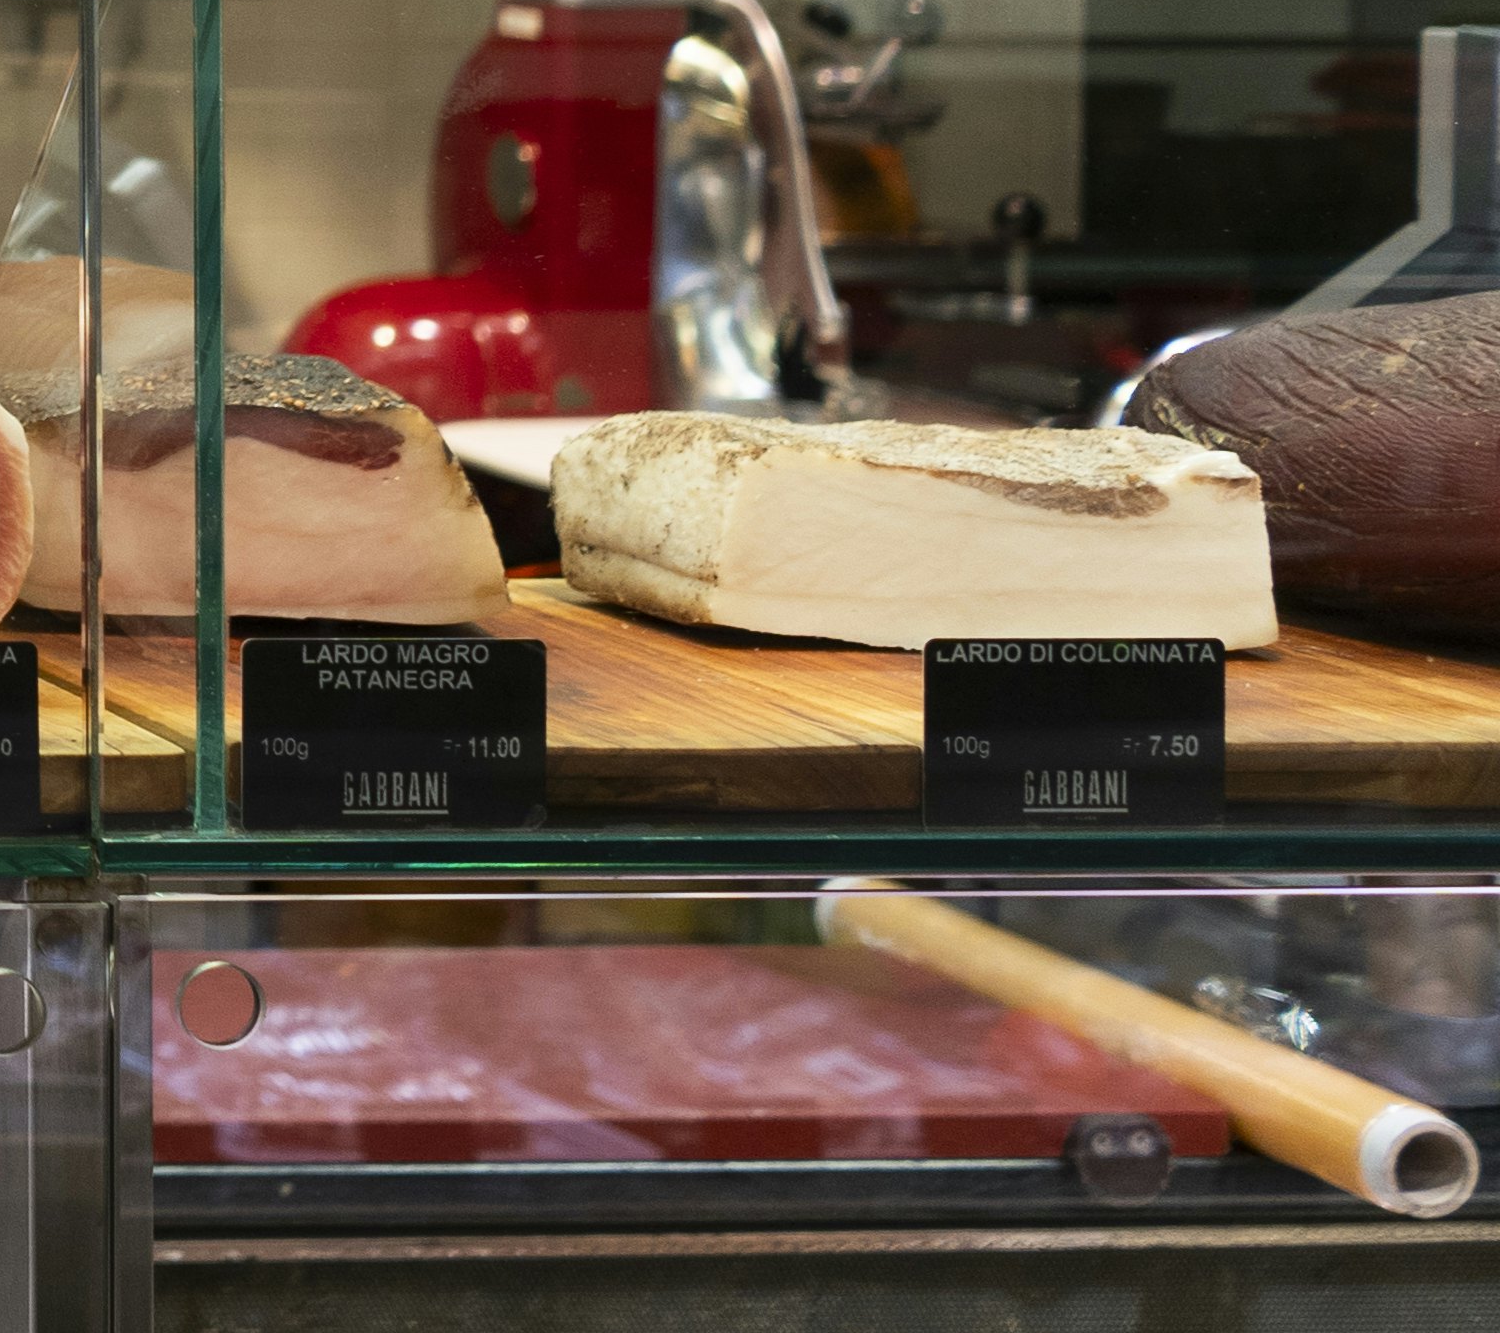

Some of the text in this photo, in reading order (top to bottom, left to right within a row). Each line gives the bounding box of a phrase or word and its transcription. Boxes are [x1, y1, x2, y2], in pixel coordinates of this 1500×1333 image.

[302, 643, 490, 664] LARDO MAGRO
[1029, 642, 1053, 663] DI
[1060, 642, 1216, 663] COLONNATA
[318, 669, 474, 690] PATANEGRA
[260, 737, 309, 761] 100g
[467, 736, 521, 758] 11.00
[942, 735, 991, 759] 100g
[1148, 734, 1199, 757] 7.50
[343, 771, 448, 808] GABBANI
[1023, 769, 1128, 806] GABBANI
